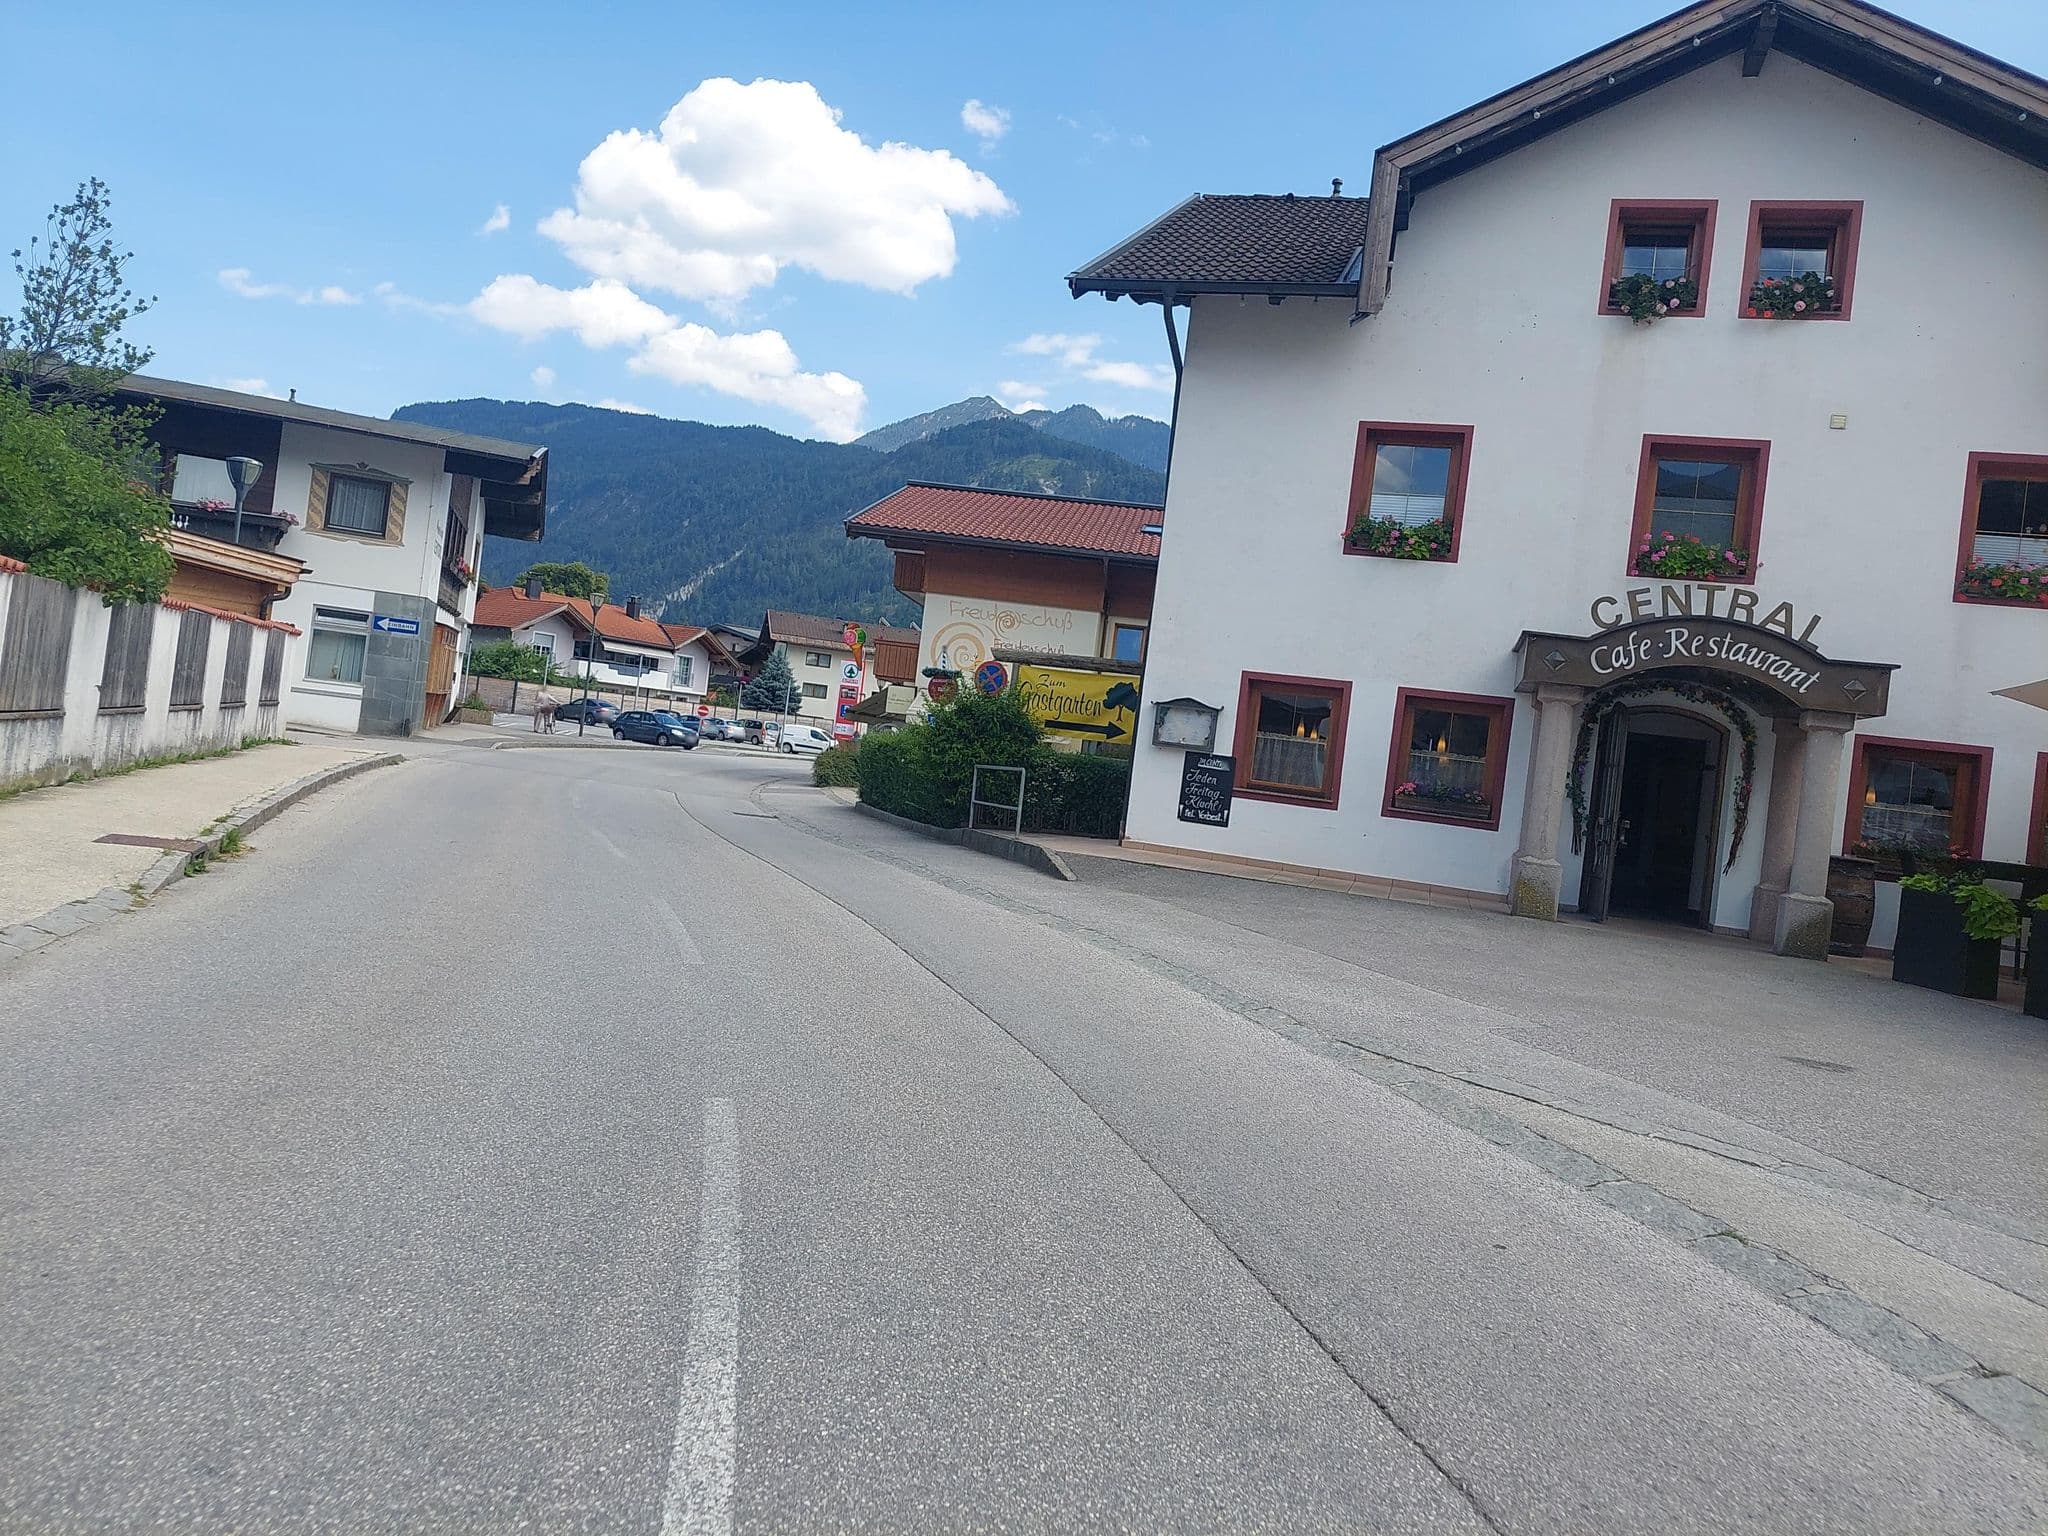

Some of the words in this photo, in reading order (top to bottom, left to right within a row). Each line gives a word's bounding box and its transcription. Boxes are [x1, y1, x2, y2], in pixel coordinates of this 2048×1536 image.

[388, 622, 414, 630] EINBAHN
[1590, 584, 1823, 650] CENTRAL
[1590, 631, 1651, 675] Cafe
[1663, 628, 1820, 694] Restaurant
[1036, 674, 1067, 690] Zum
[1019, 681, 1102, 720] Gastgarten
[1186, 768, 1217, 785] Jeden
